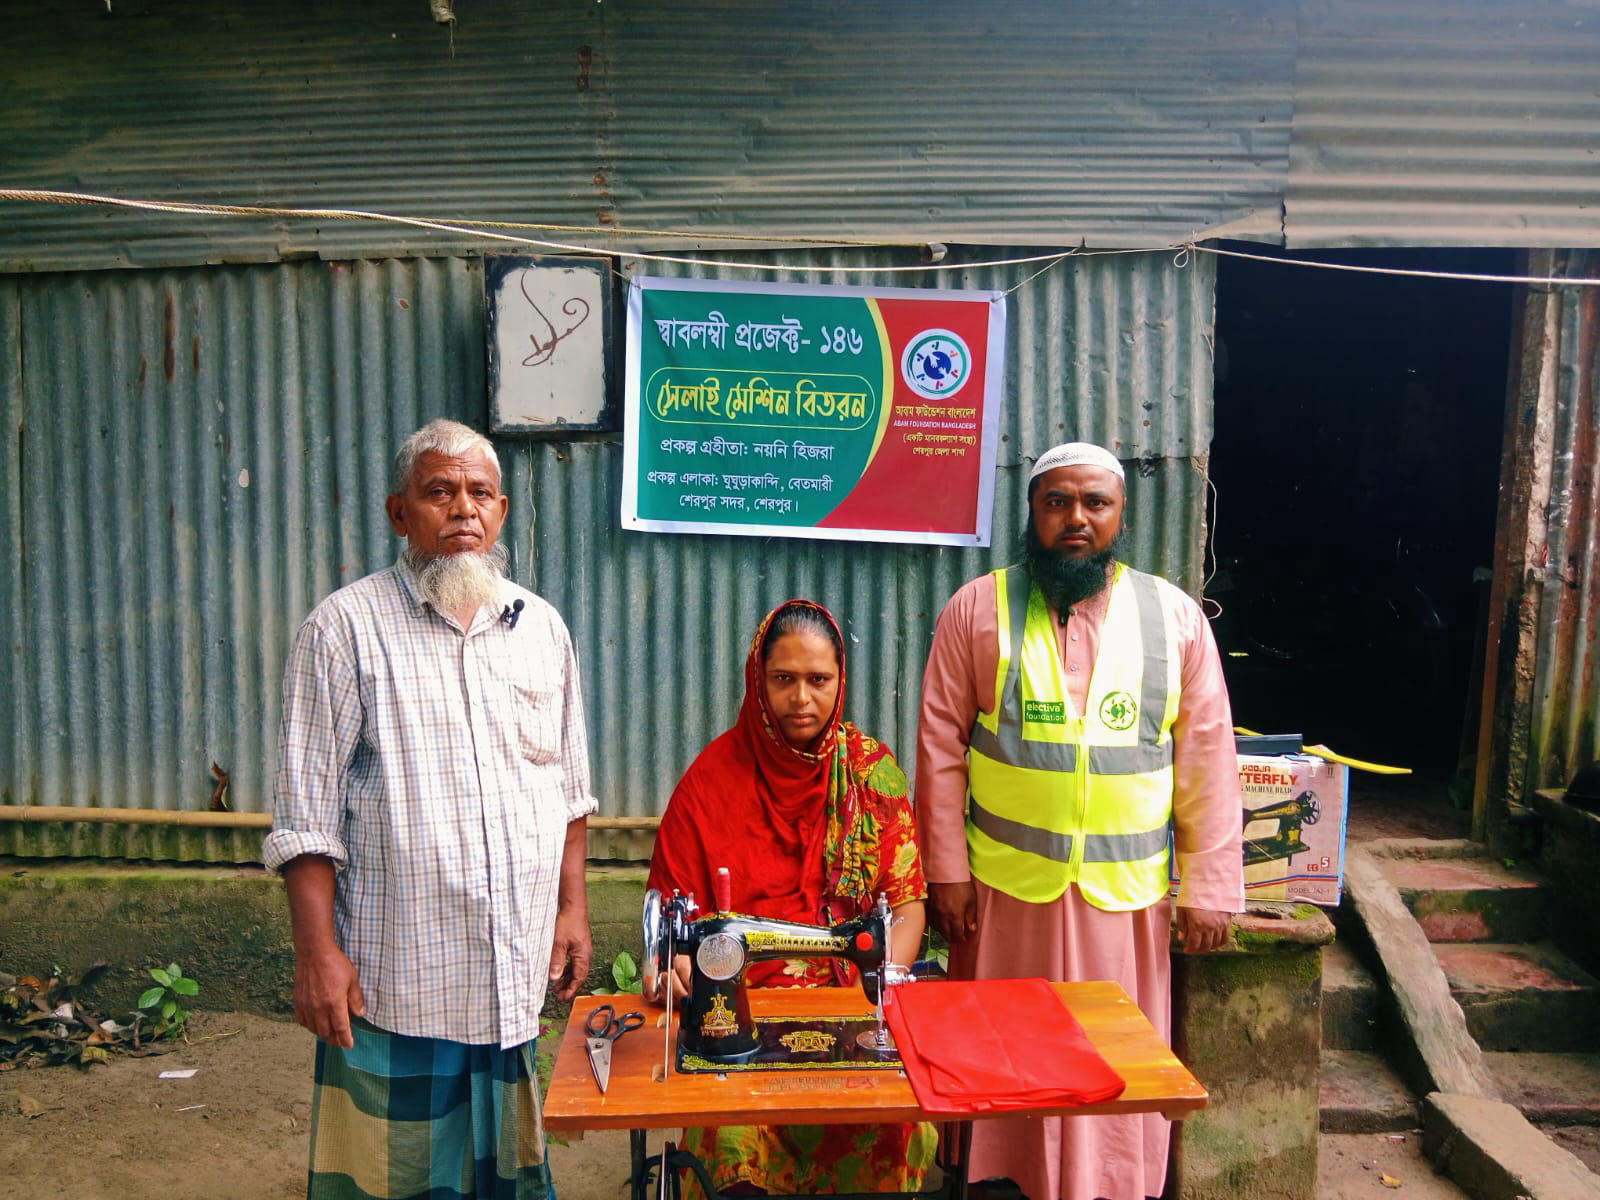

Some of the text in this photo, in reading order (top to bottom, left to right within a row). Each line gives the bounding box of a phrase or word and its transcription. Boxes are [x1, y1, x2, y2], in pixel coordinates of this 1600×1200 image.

[654, 311, 729, 350] স্বাবলম্বী
[820, 325, 863, 355] ১৪৬
[657, 377, 867, 421] সেলাই মেশিন বিতরন
[947, 407, 976, 418] বাংলাদেশ
[942, 421, 976, 429] BANGLADESH
[660, 437, 698, 455] প্রকল্প
[752, 439, 789, 459] নয়নি
[792, 440, 835, 461] হিজরা
[647, 470, 677, 485] প্রকল্প
[788, 475, 834, 492] বেতমারী
[679, 494, 718, 511] শেরপুর
